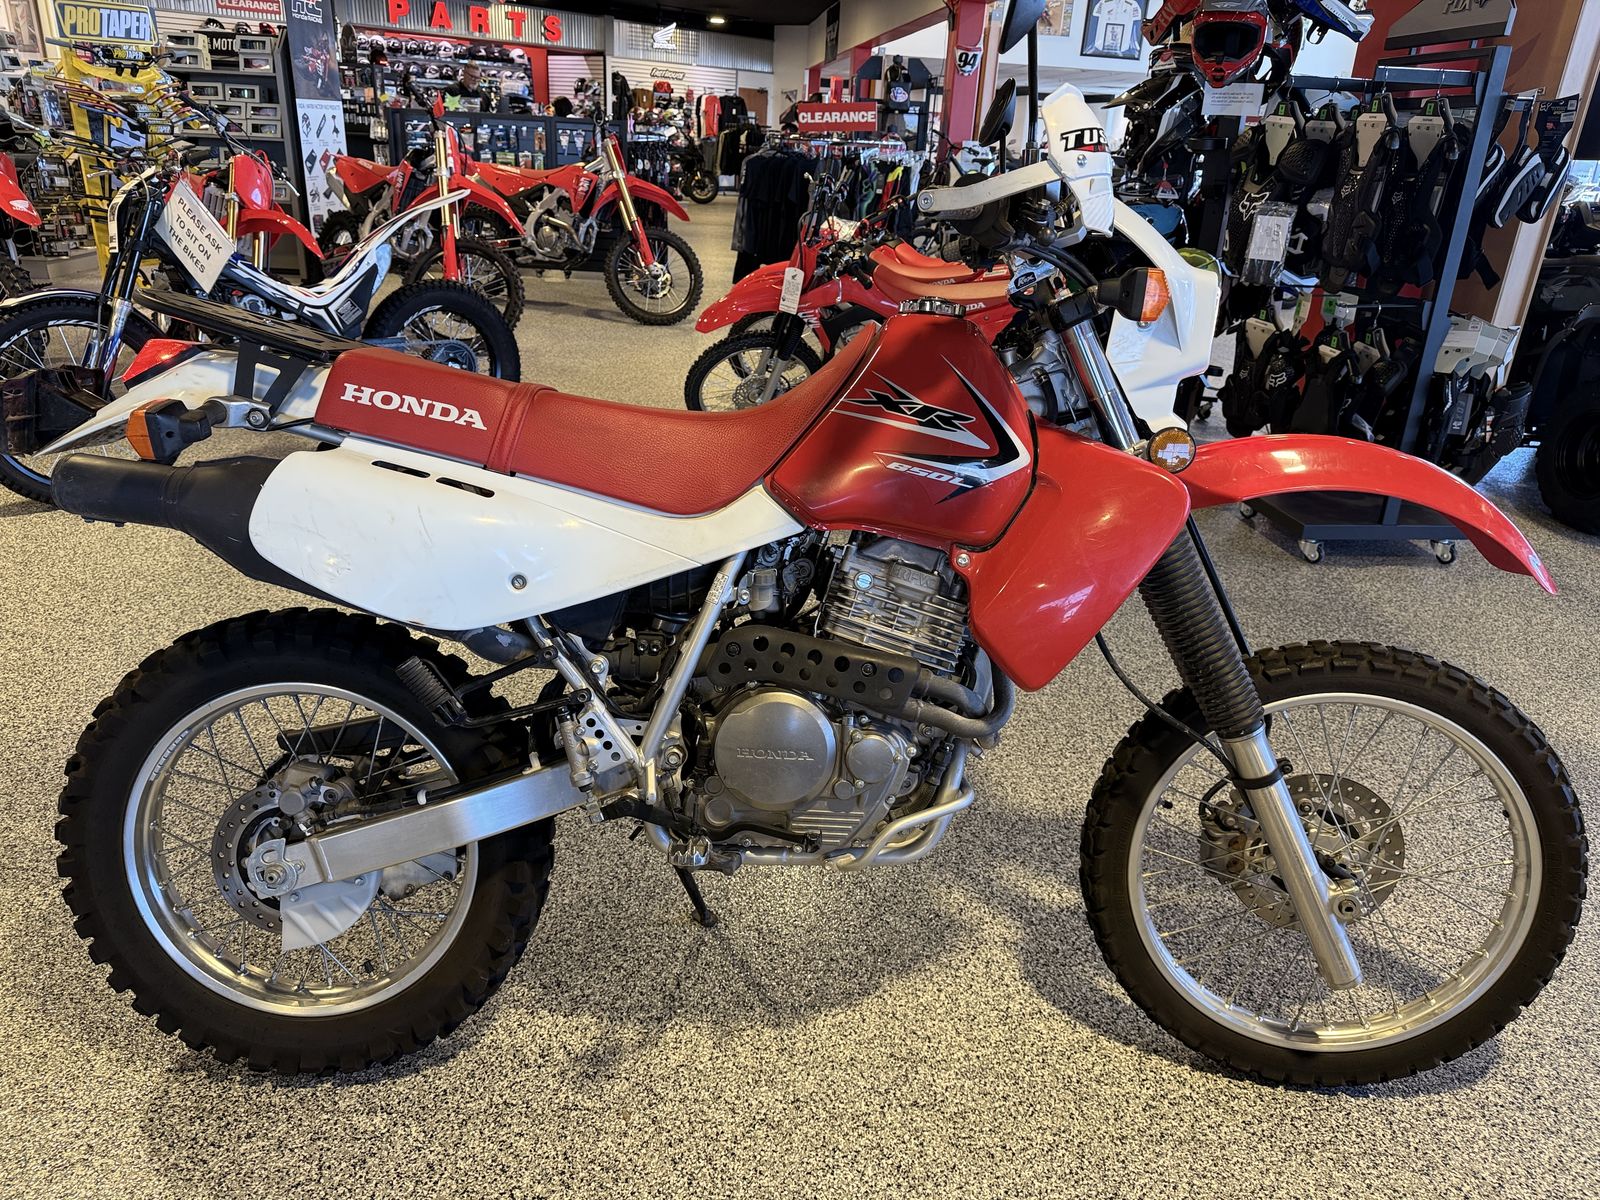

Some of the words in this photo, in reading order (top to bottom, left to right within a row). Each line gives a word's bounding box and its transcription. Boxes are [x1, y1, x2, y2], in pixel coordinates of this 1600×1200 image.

[388, 0, 563, 43] PARTS
[957, 52, 978, 69] 94
[799, 110, 876, 123] CLEARANCE
[175, 214, 186, 230] TO
[185, 228, 199, 244] SIT
[197, 243, 212, 261] ON
[177, 197, 207, 235] PLEASE
[204, 233, 223, 254] ASK
[168, 225, 184, 247] THE
[182, 244, 206, 273] BIKES
[340, 382, 488, 430] HONDA
[886, 461, 974, 488] 650L
[736, 747, 815, 761] HONDA
